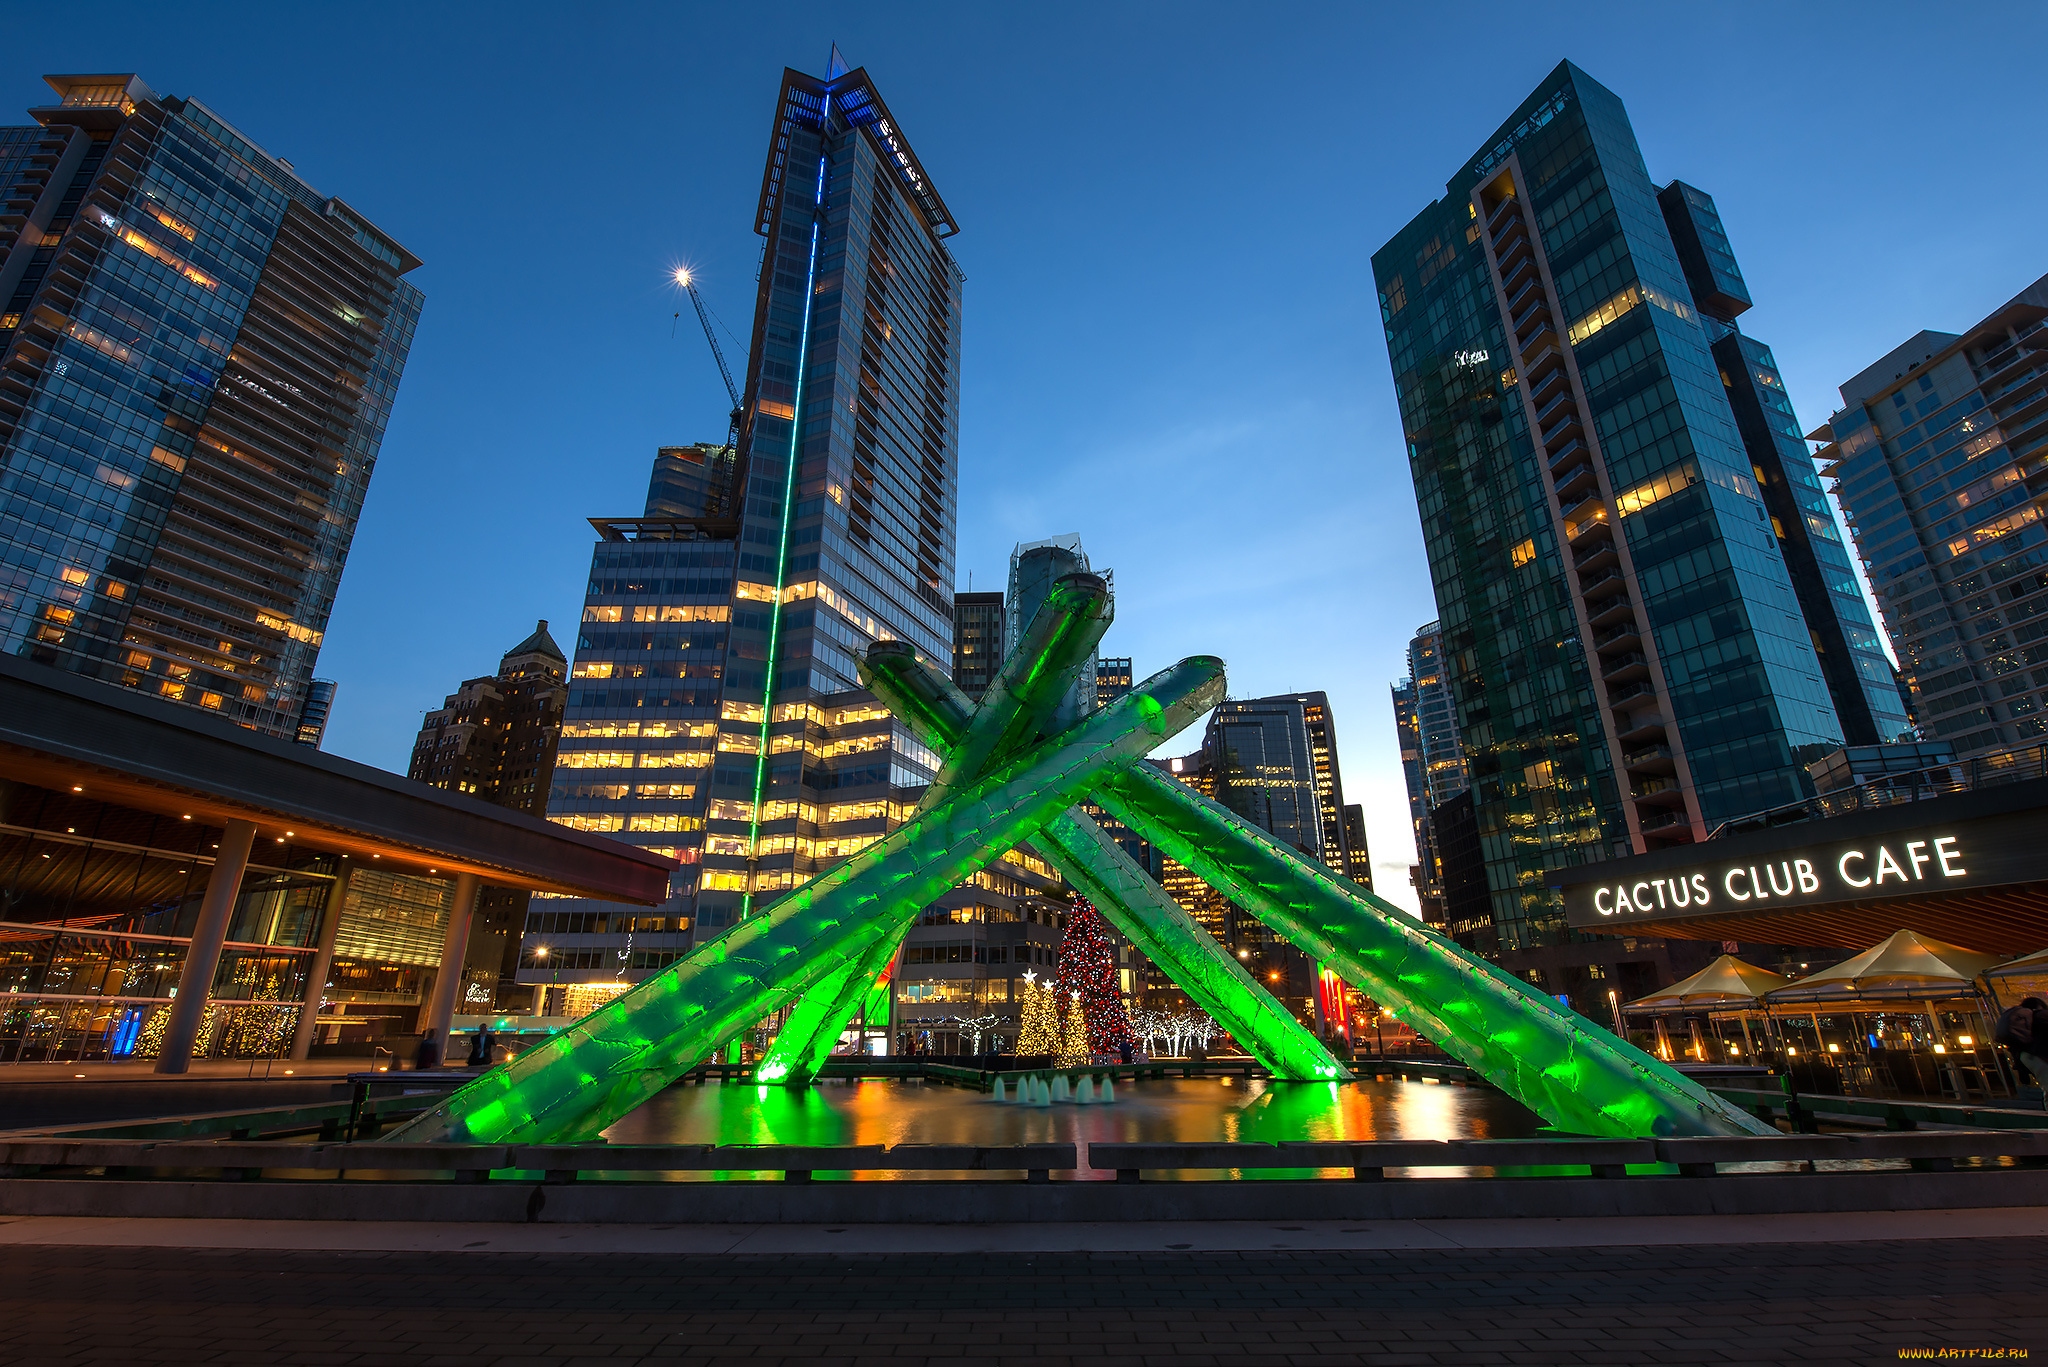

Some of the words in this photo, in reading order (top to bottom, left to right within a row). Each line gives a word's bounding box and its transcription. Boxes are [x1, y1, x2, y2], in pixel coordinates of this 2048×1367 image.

[1593, 873, 1711, 917] CACTUS
[1723, 858, 1820, 902] CLUB
[1837, 835, 1967, 889] CAFE
